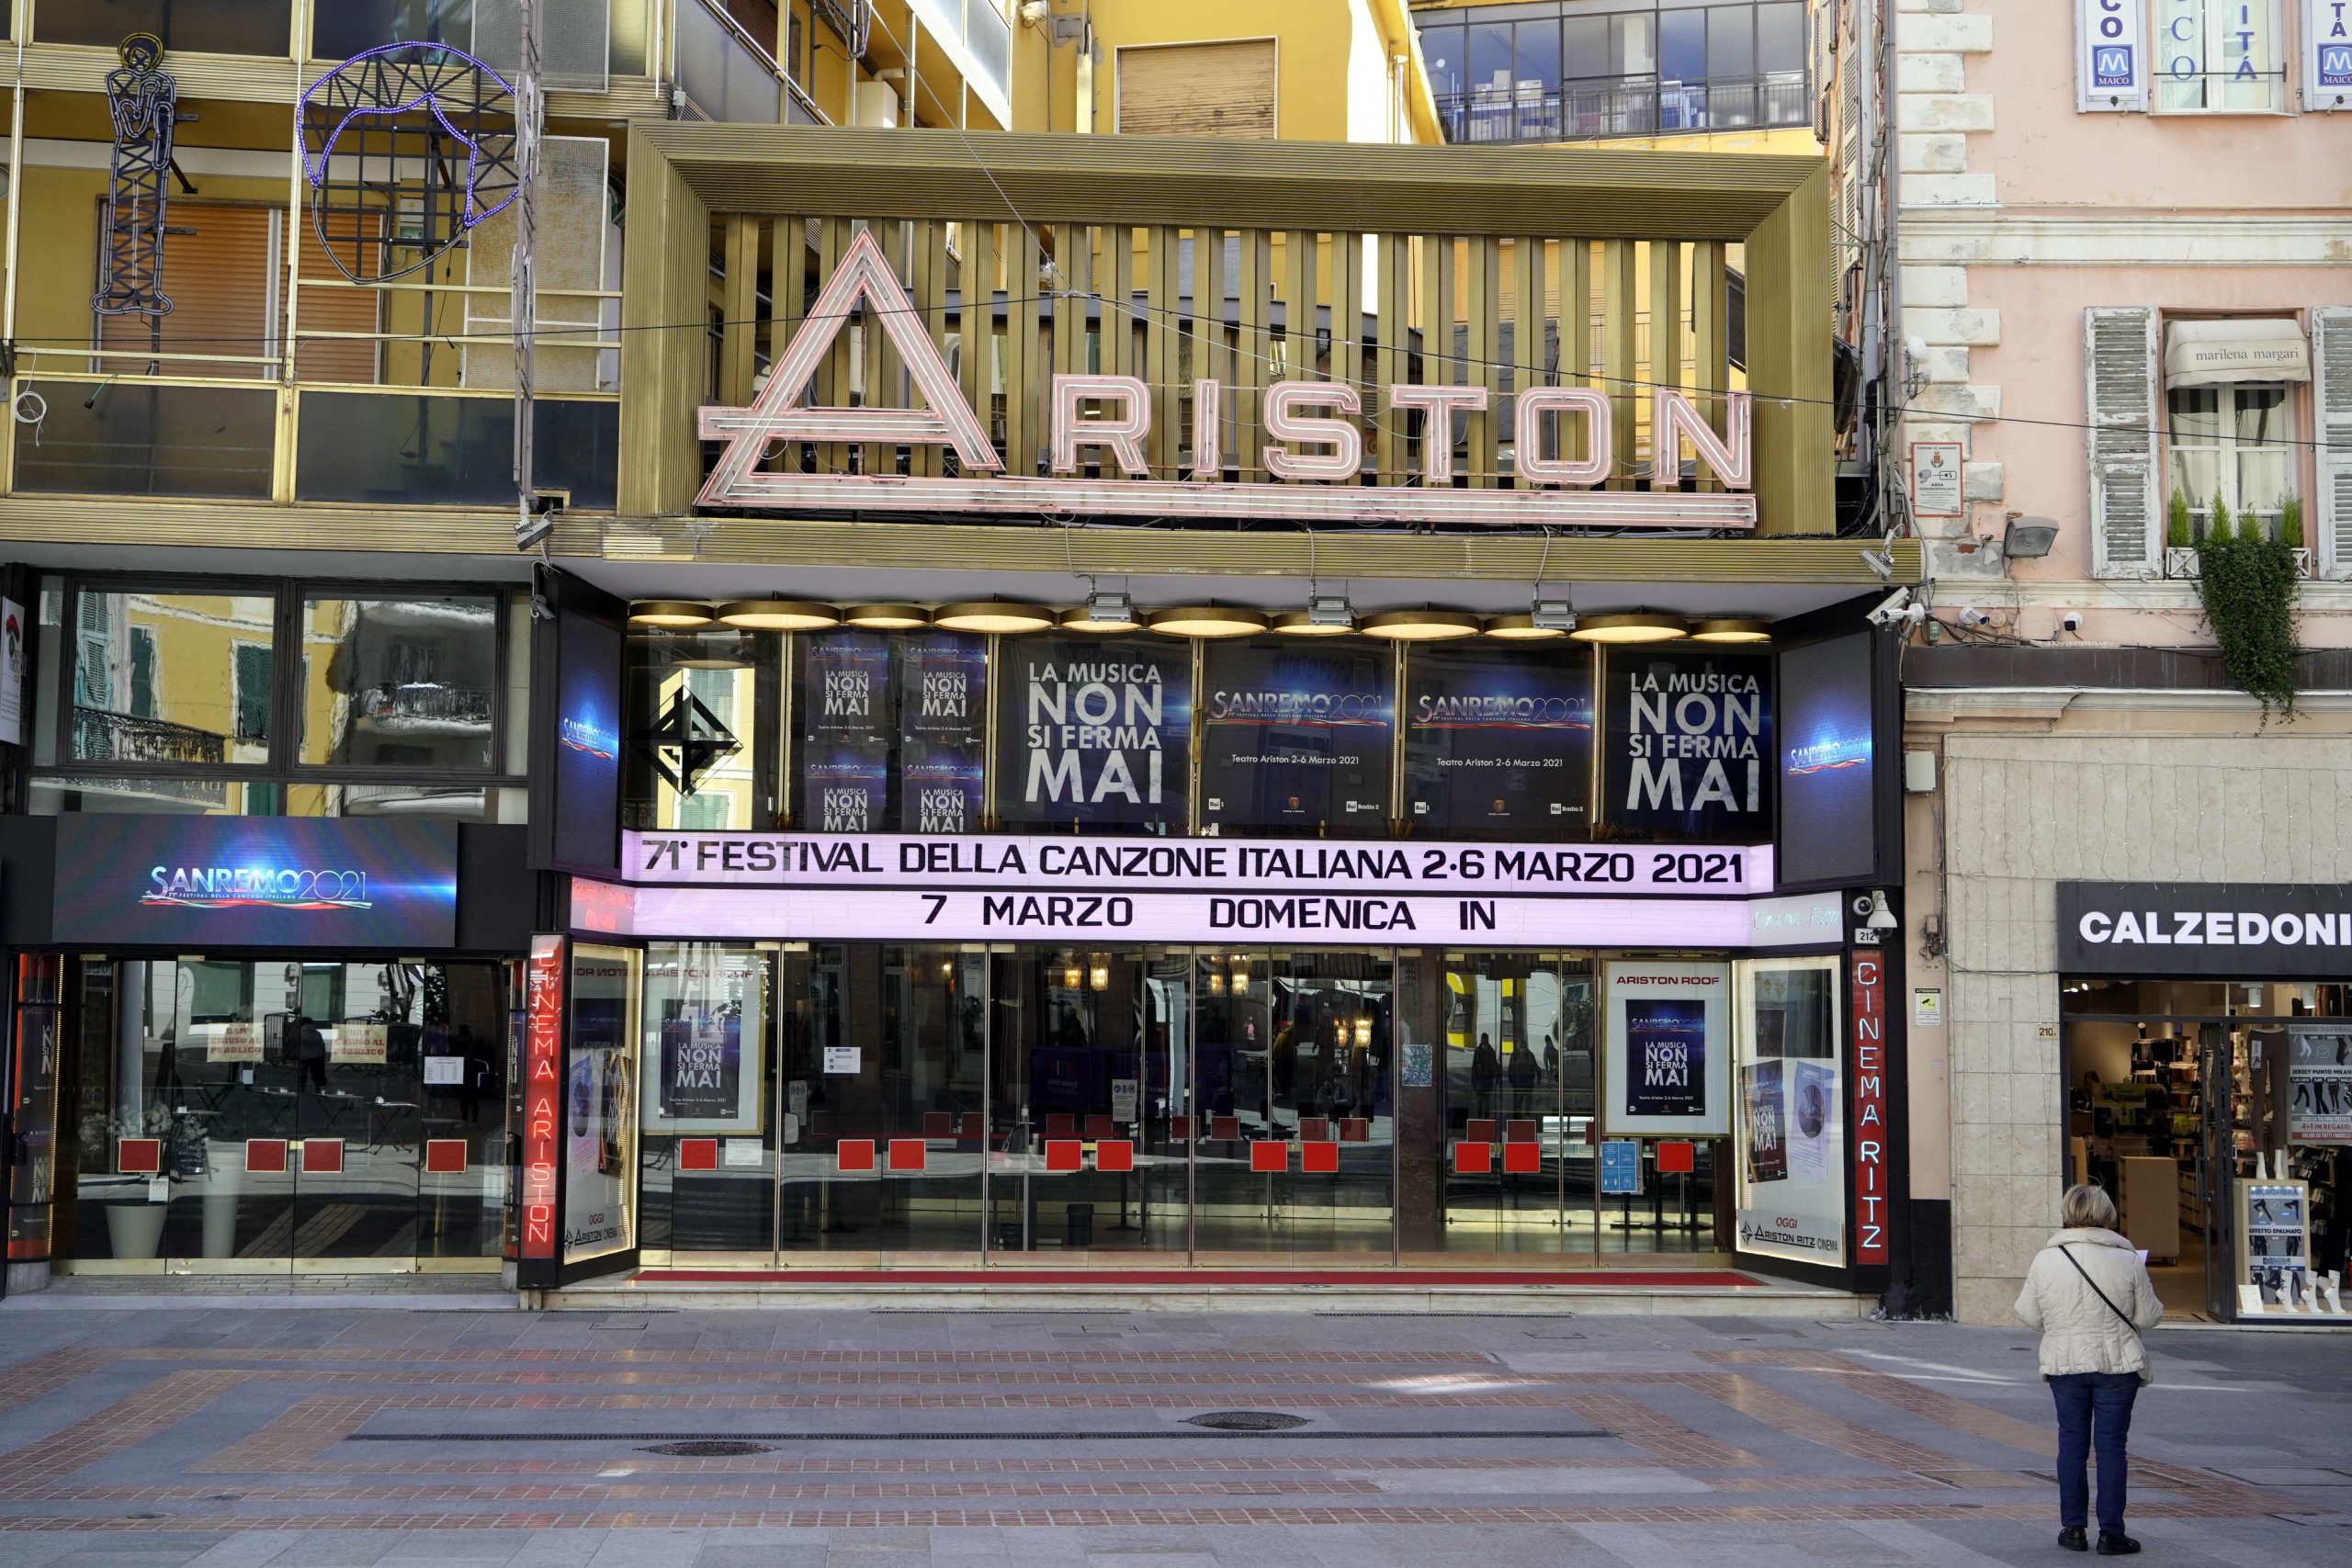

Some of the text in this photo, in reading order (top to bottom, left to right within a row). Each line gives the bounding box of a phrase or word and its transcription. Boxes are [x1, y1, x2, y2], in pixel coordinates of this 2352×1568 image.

[2098, 77, 2130, 85] MAICO
[2196, 347, 2299, 362] marilena margari
[695, 227, 1756, 525] ARISTON
[1029, 662, 1162, 683] LA MUSICA
[826, 677, 869, 691] NON
[923, 679, 966, 692] NON
[1631, 672, 1759, 694] LA MUSICA
[933, 692, 966, 700] FERMA
[1028, 682, 1162, 727] NON
[824, 698, 869, 716] MAI
[922, 699, 966, 716] MAI
[1630, 692, 1760, 736] NON
[1027, 725, 1161, 750] SI FERMA
[1629, 734, 1759, 759] SI FERMA
[1232, 754, 1359, 764] Teatro Ariston 2-6 Marzo 2021
[1437, 758, 1563, 767] Teatro Ariston 2-6 Marzo 2021
[1025, 749, 1162, 804] MAI
[1626, 758, 1759, 812] MAI
[824, 795, 867, 808] NON
[921, 795, 964, 809] NON
[823, 816, 867, 831] MAI
[920, 817, 964, 832] MAI
[697, 840, 883, 873] FESTIVAL
[899, 842, 1027, 874] DELLA
[1039, 845, 1227, 878] CANZONE
[1238, 848, 1413, 880] ITALIANA
[1495, 851, 1634, 882] MARZO
[1653, 853, 1744, 883] 2021
[921, 895, 1496, 931] 7 MARZO DOMENICA IN
[1860, 931, 1874, 941] 212
[2079, 911, 2352, 945] CALZEDONI
[1616, 976, 1720, 985] ARISTON ROOF
[535, 950, 556, 1079] CINEMA
[1858, 962, 1881, 1126] CINEMA
[677, 1049, 721, 1063] NON
[1645, 1048, 1688, 1062] NON
[676, 1070, 721, 1088] MAI
[1645, 1069, 1688, 1086] MAI
[528, 1098, 552, 1243] ARISTON
[1860, 1141, 1882, 1248] RITZ
[589, 1213, 605, 1225] OGGI
[1776, 1216, 1798, 1229] OGGI
[1754, 1224, 1838, 1251] ARISTON RITZ CINEMA
